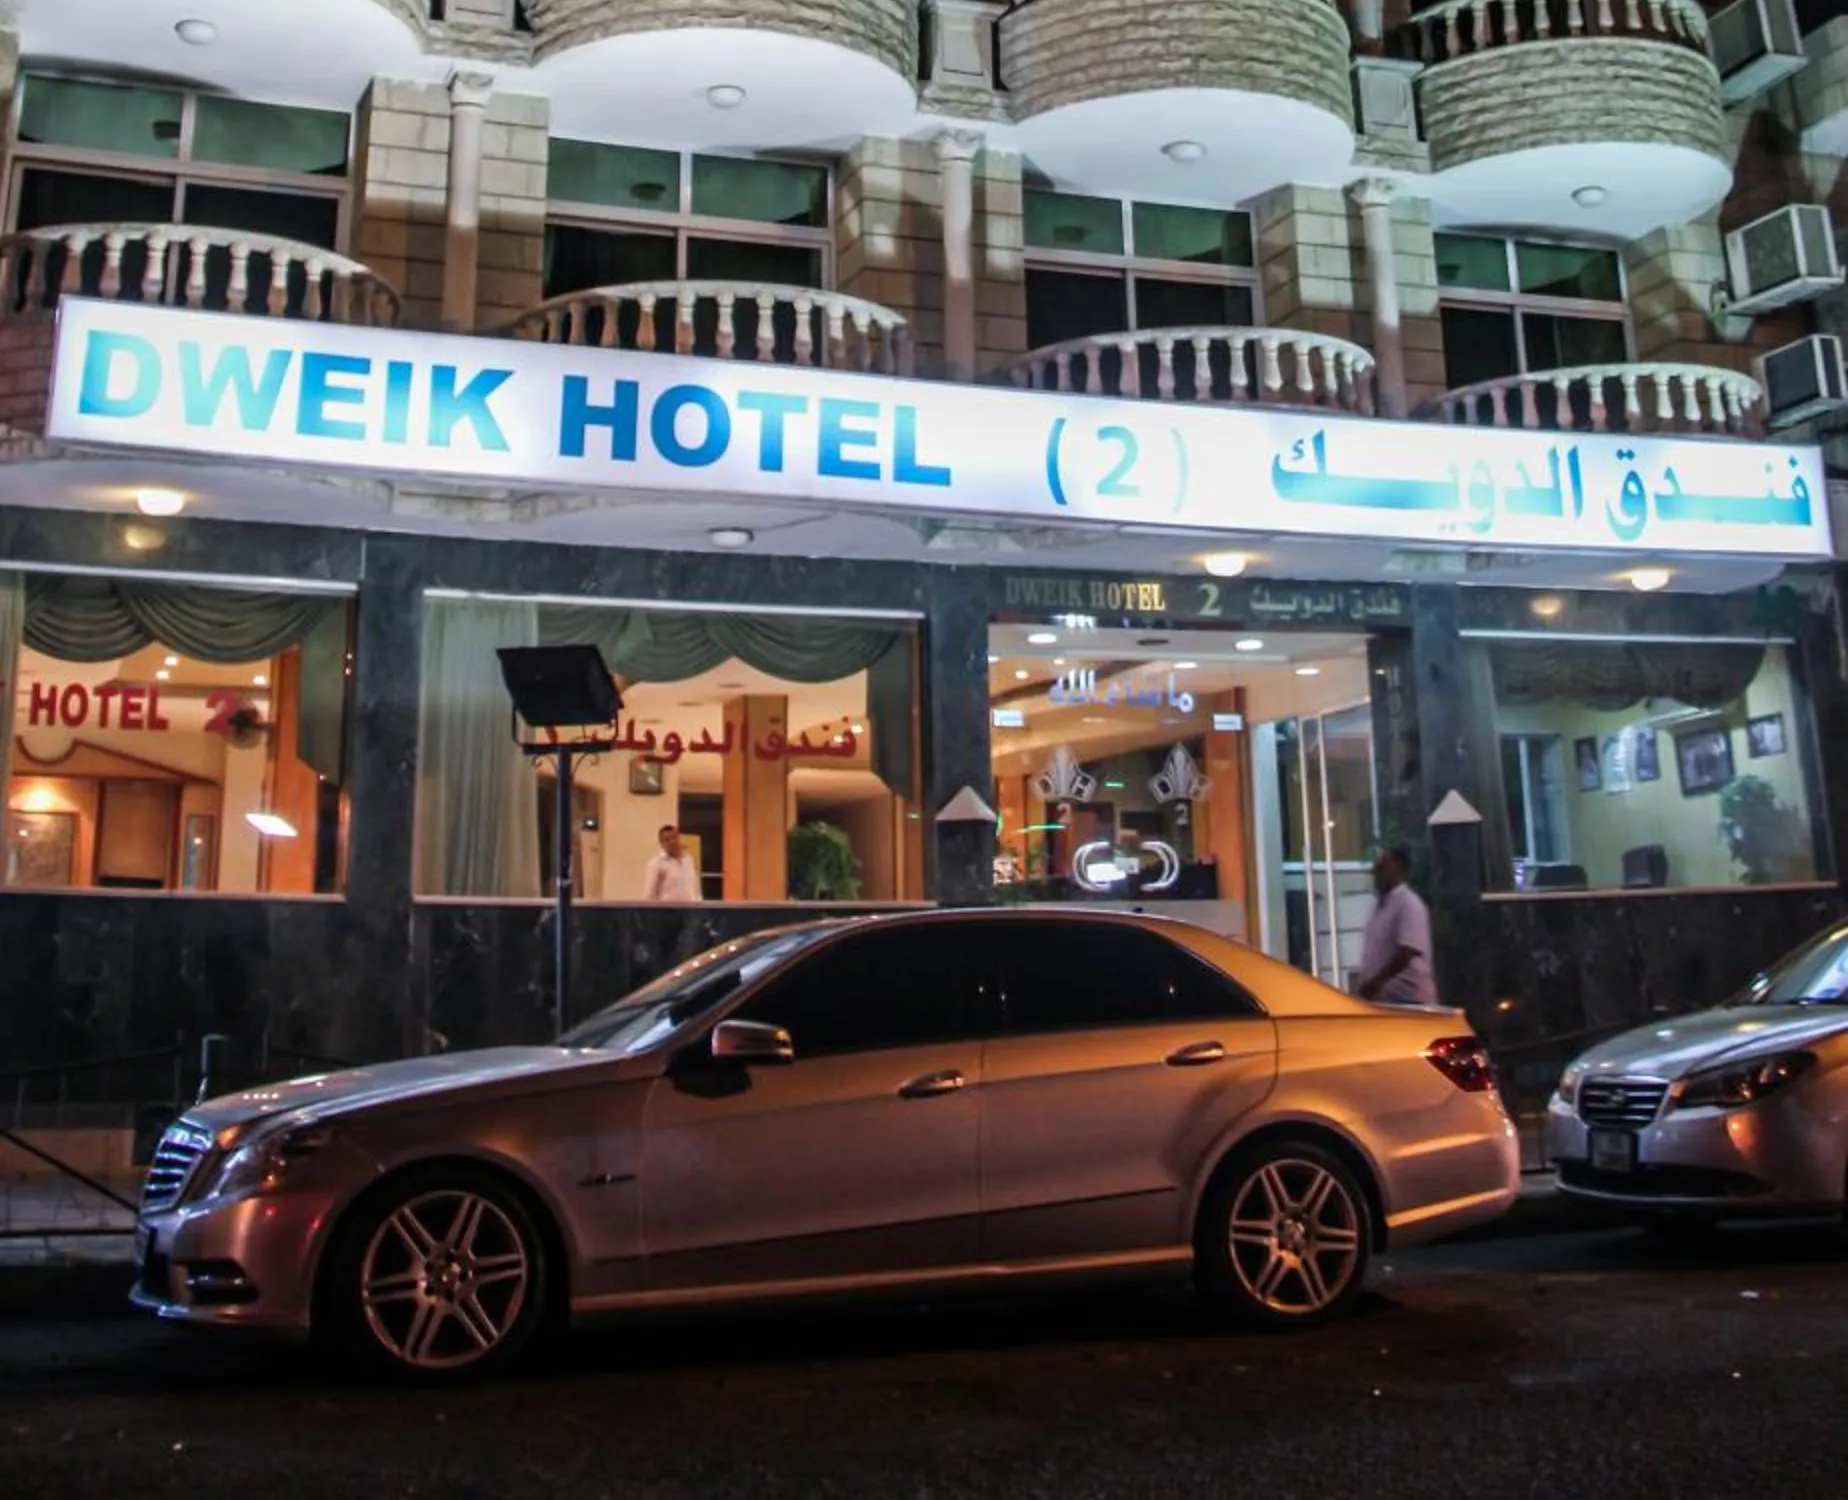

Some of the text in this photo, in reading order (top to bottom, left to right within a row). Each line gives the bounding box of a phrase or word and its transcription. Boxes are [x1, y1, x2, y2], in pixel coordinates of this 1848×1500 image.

[78, 328, 515, 453] DWEIK
[559, 374, 953, 487] HOTEL
[1271, 428, 1813, 542] فندق الدويك
[1005, 576, 1223, 617] DWEIK HOTEL 2
[1350, 587, 1401, 620] فندق
[29, 682, 169, 731] HOTEL
[754, 716, 857, 761] فندق
